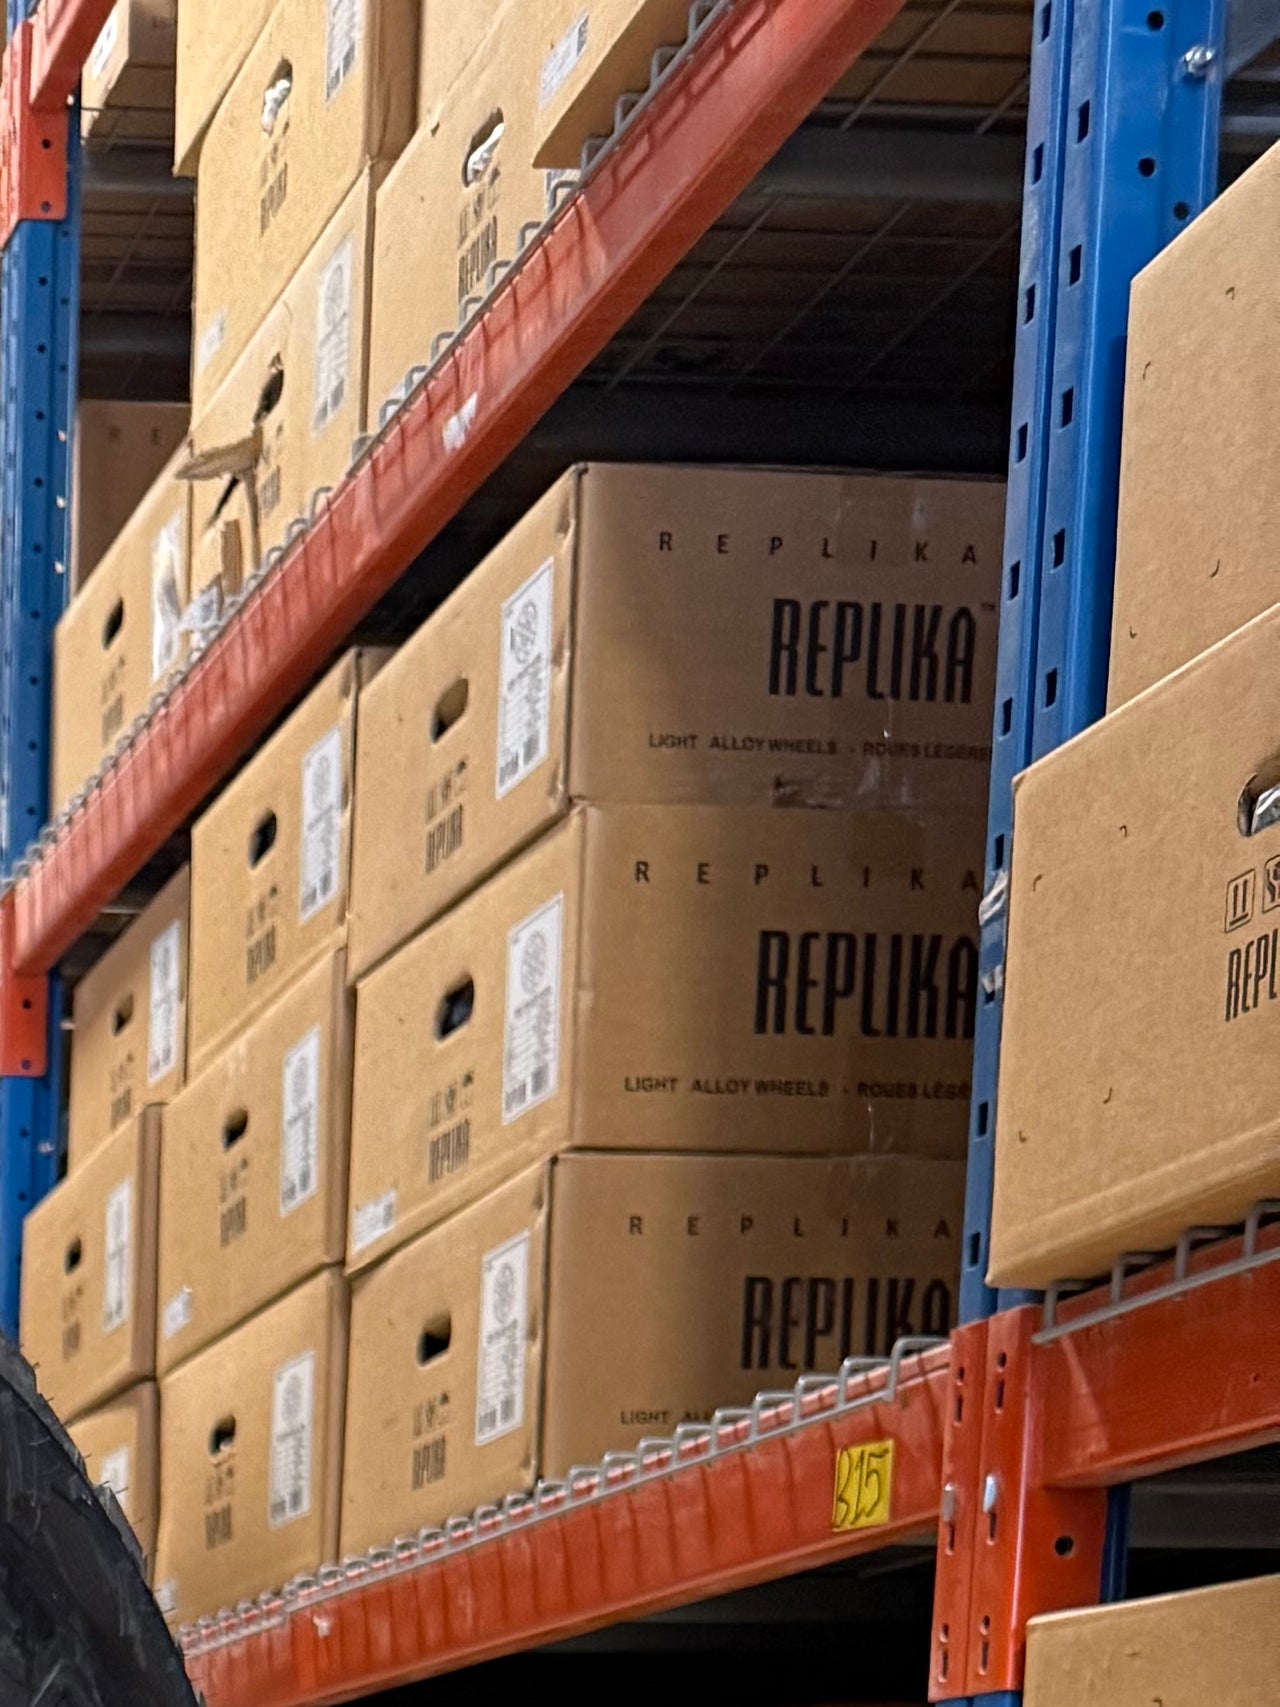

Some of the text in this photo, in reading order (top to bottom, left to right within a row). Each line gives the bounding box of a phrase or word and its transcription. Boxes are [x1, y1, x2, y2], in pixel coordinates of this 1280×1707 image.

[659, 531, 977, 565] REPLIKA
[768, 598, 977, 704] REPLIKA
[648, 733, 697, 750] LIGHT
[709, 735, 766, 751] ALLOY
[767, 738, 837, 756] WHEELS
[634, 861, 978, 890] REPLIKA
[755, 930, 979, 1039] REPLIKA
[1225, 927, 1278, 1022] REPL
[624, 1077, 677, 1093] LIGHT
[692, 1078, 747, 1094] ALLOY
[753, 1080, 830, 1097] WHEELS
[629, 1217, 951, 1239] REPLIKA
[620, 1411, 668, 1425] LIGHT
